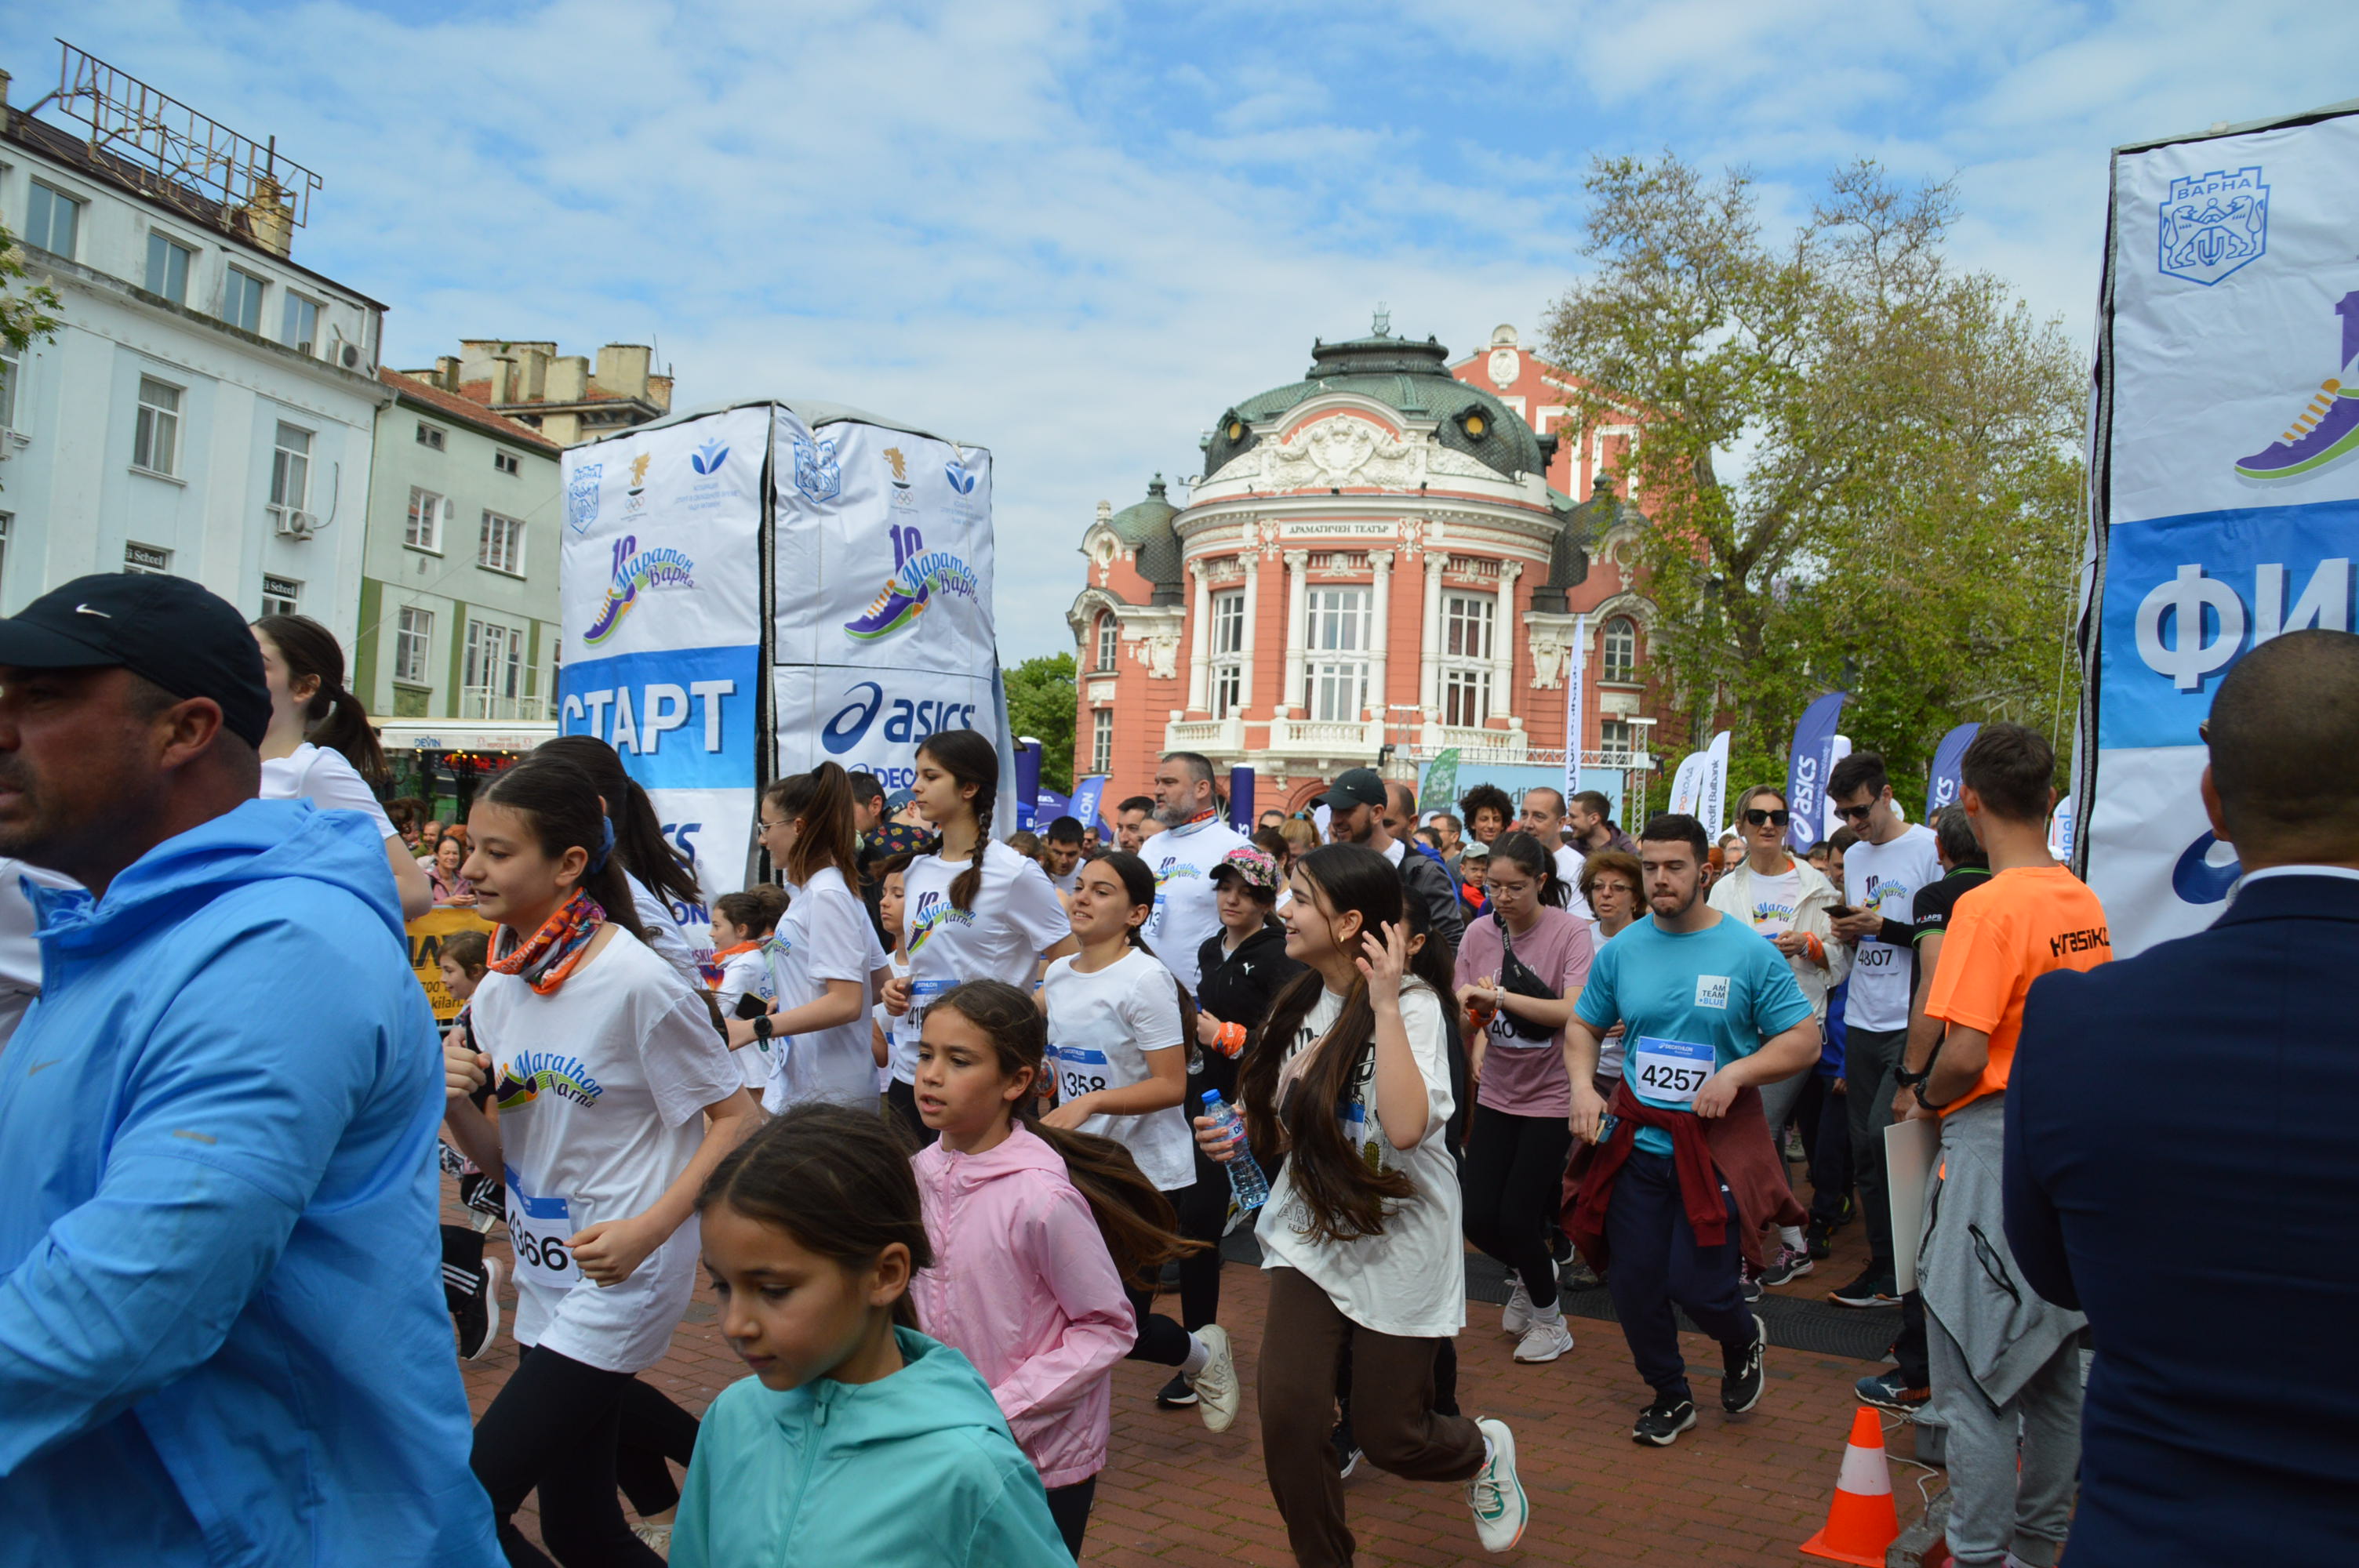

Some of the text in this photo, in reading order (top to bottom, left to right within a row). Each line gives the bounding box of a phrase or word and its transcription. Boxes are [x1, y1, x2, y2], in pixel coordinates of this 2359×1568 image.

[2176, 178, 2251, 200] ВАРНА
[1289, 524, 1390, 534] ДРАМАТИЧЕН ТЕАТЪР
[134, 550, 164, 566] School
[616, 547, 694, 591] Маратон
[646, 564, 695, 588] Варна
[903, 552, 978, 594] Маратон
[271, 582, 296, 596] School
[937, 569, 979, 604] Варна
[414, 736, 441, 748] DEVIN
[1708, 759, 1720, 804] Bulbank
[1870, 879, 1908, 898] Marathon
[942, 912, 972, 928] Varna
[1858, 949, 1893, 967] 4807
[1703, 989, 1725, 999] TEAM
[514, 1049, 603, 1098] Marathon
[1641, 1064, 1707, 1092] 4257
[547, 1073, 595, 1109] Varna
[508, 1209, 569, 1271] 4366
